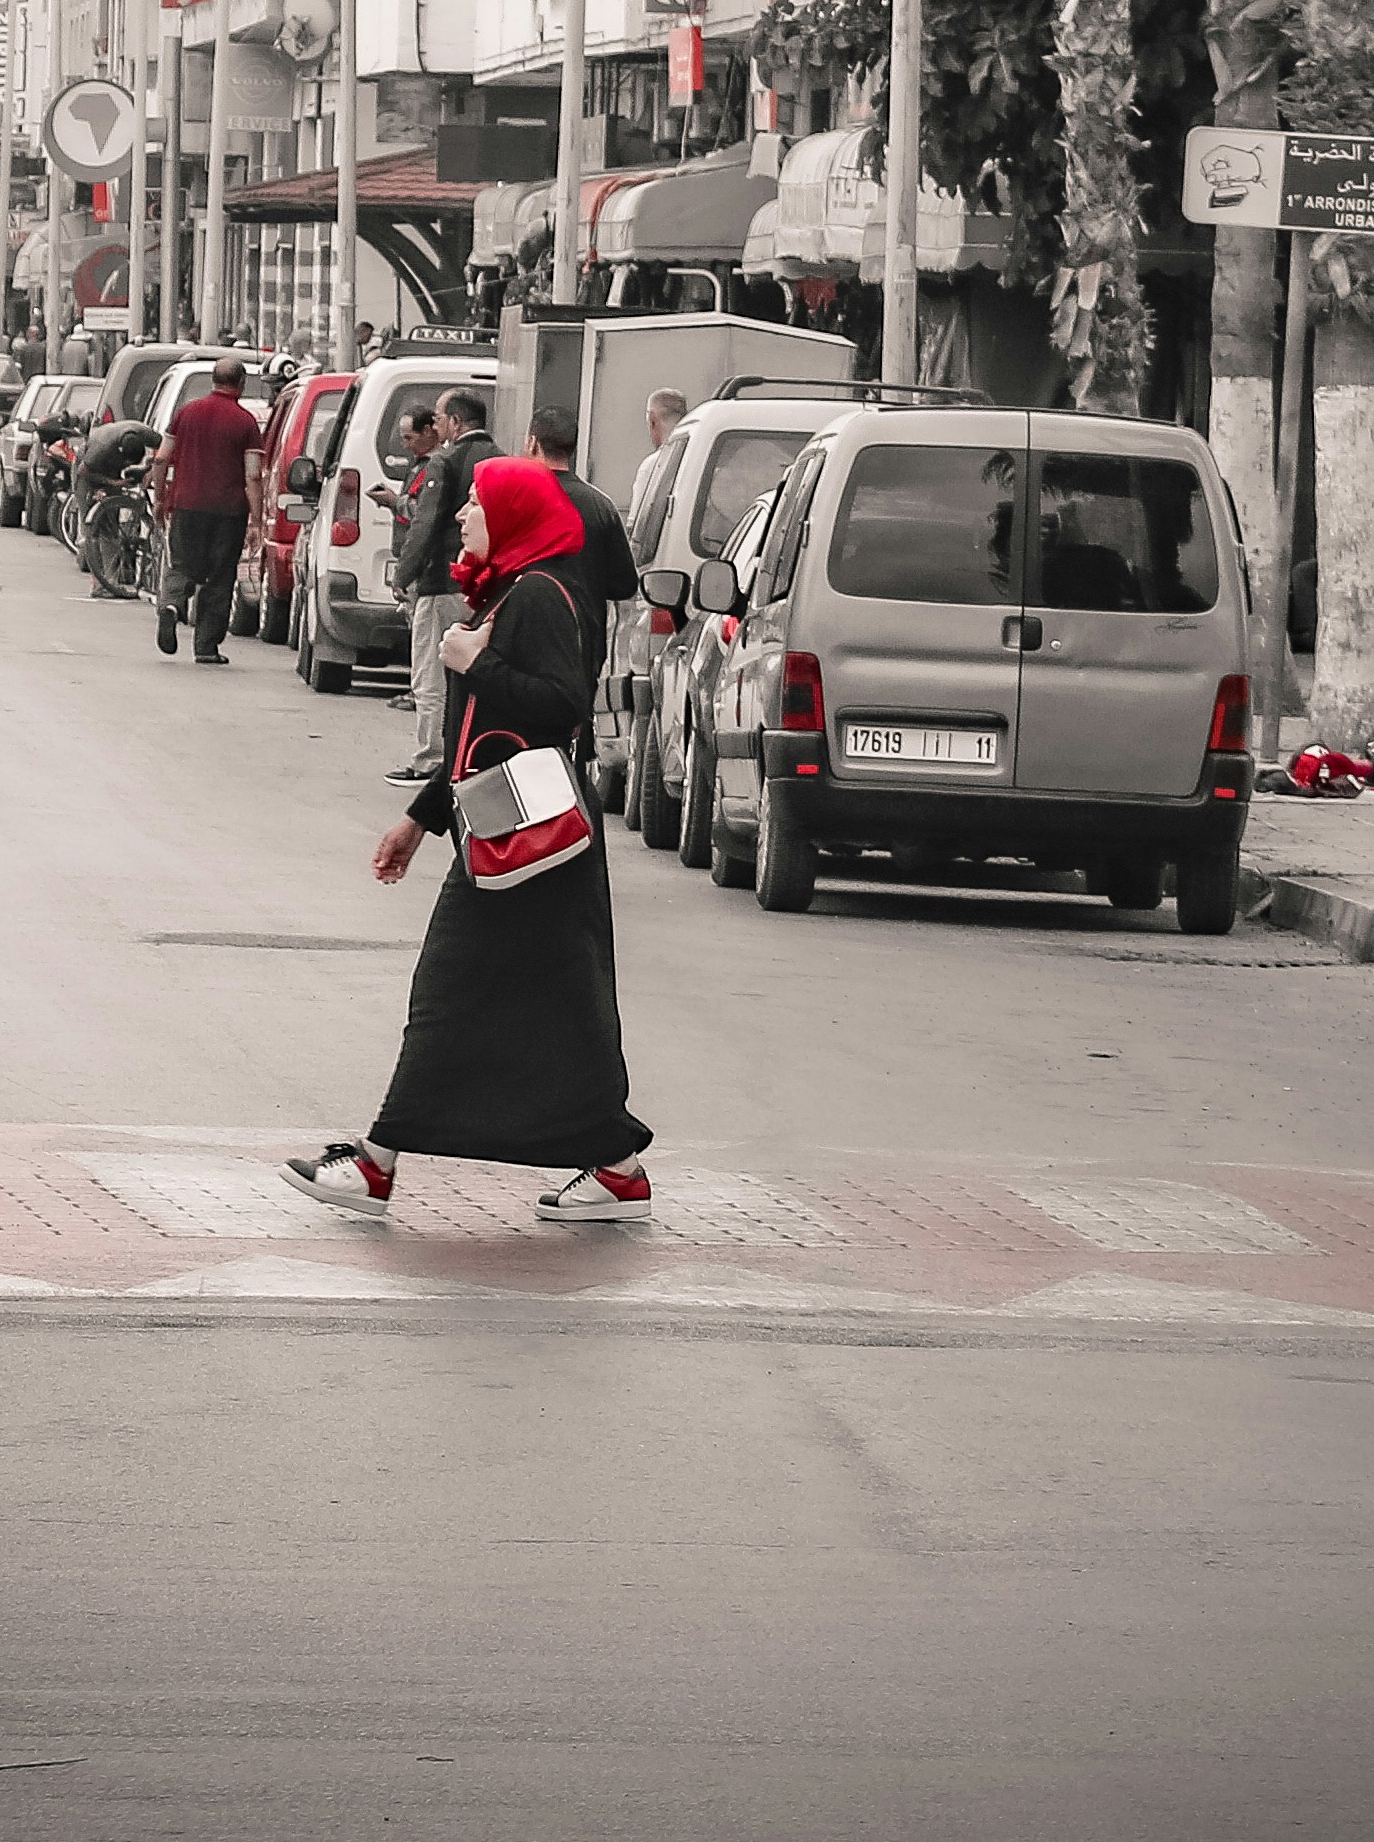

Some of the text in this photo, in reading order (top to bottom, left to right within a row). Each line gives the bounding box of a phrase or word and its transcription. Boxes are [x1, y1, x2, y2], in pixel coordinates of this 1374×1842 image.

[231, 78, 283, 86] VOLVO
[227, 117, 290, 129] ERVICE
[1288, 139, 1362, 165] الحضرية
[421, 328, 466, 341] TAXI
[852, 729, 902, 754] 17619
[977, 737, 991, 759] 11
